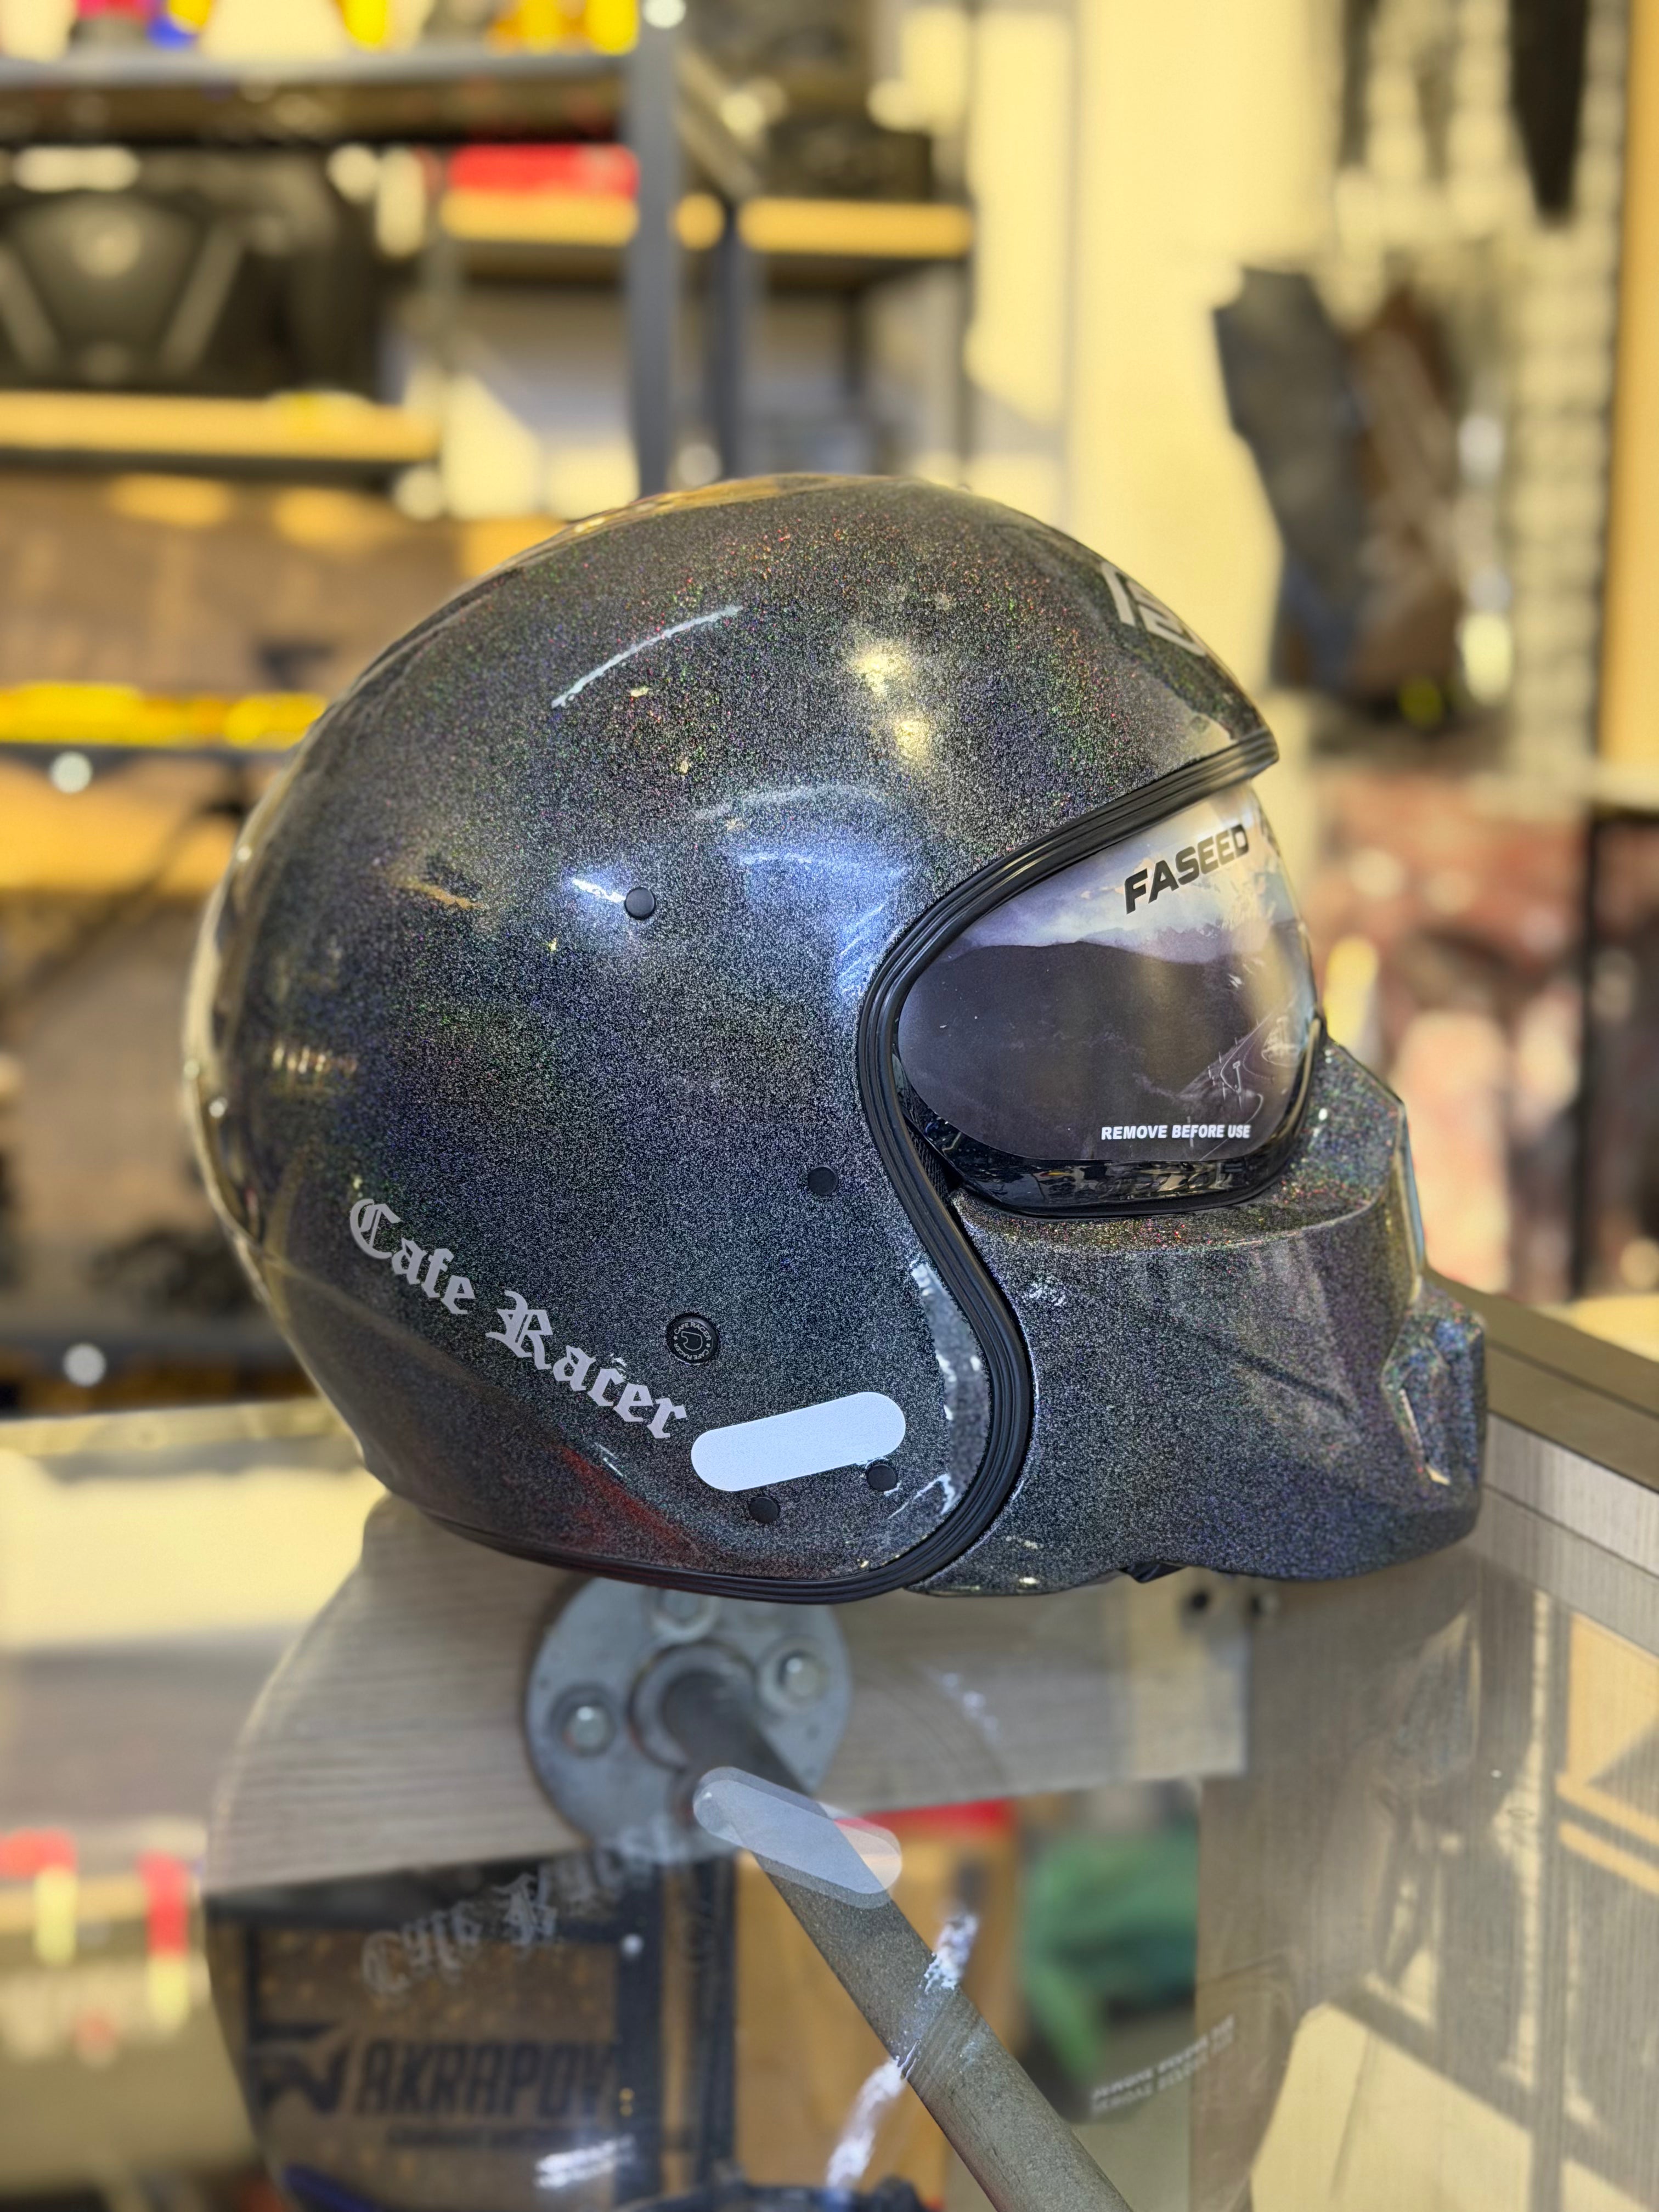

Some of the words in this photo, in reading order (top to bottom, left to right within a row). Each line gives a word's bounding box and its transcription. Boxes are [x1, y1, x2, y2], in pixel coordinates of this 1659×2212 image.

[1125, 824, 1249, 915] FASEED
[1101, 1126, 1167, 1140] REMOVE
[1172, 1125, 1226, 1139] BEFORE
[1227, 1124, 1251, 1138] USE
[349, 1198, 476, 1314] Cafe
[486, 1290, 687, 1439] Racer
[674, 1322, 690, 1335] CAFE
[690, 1322, 712, 1341] RACER
[674, 1342, 692, 1360] RACER
[692, 1349, 709, 1360] CAFE
